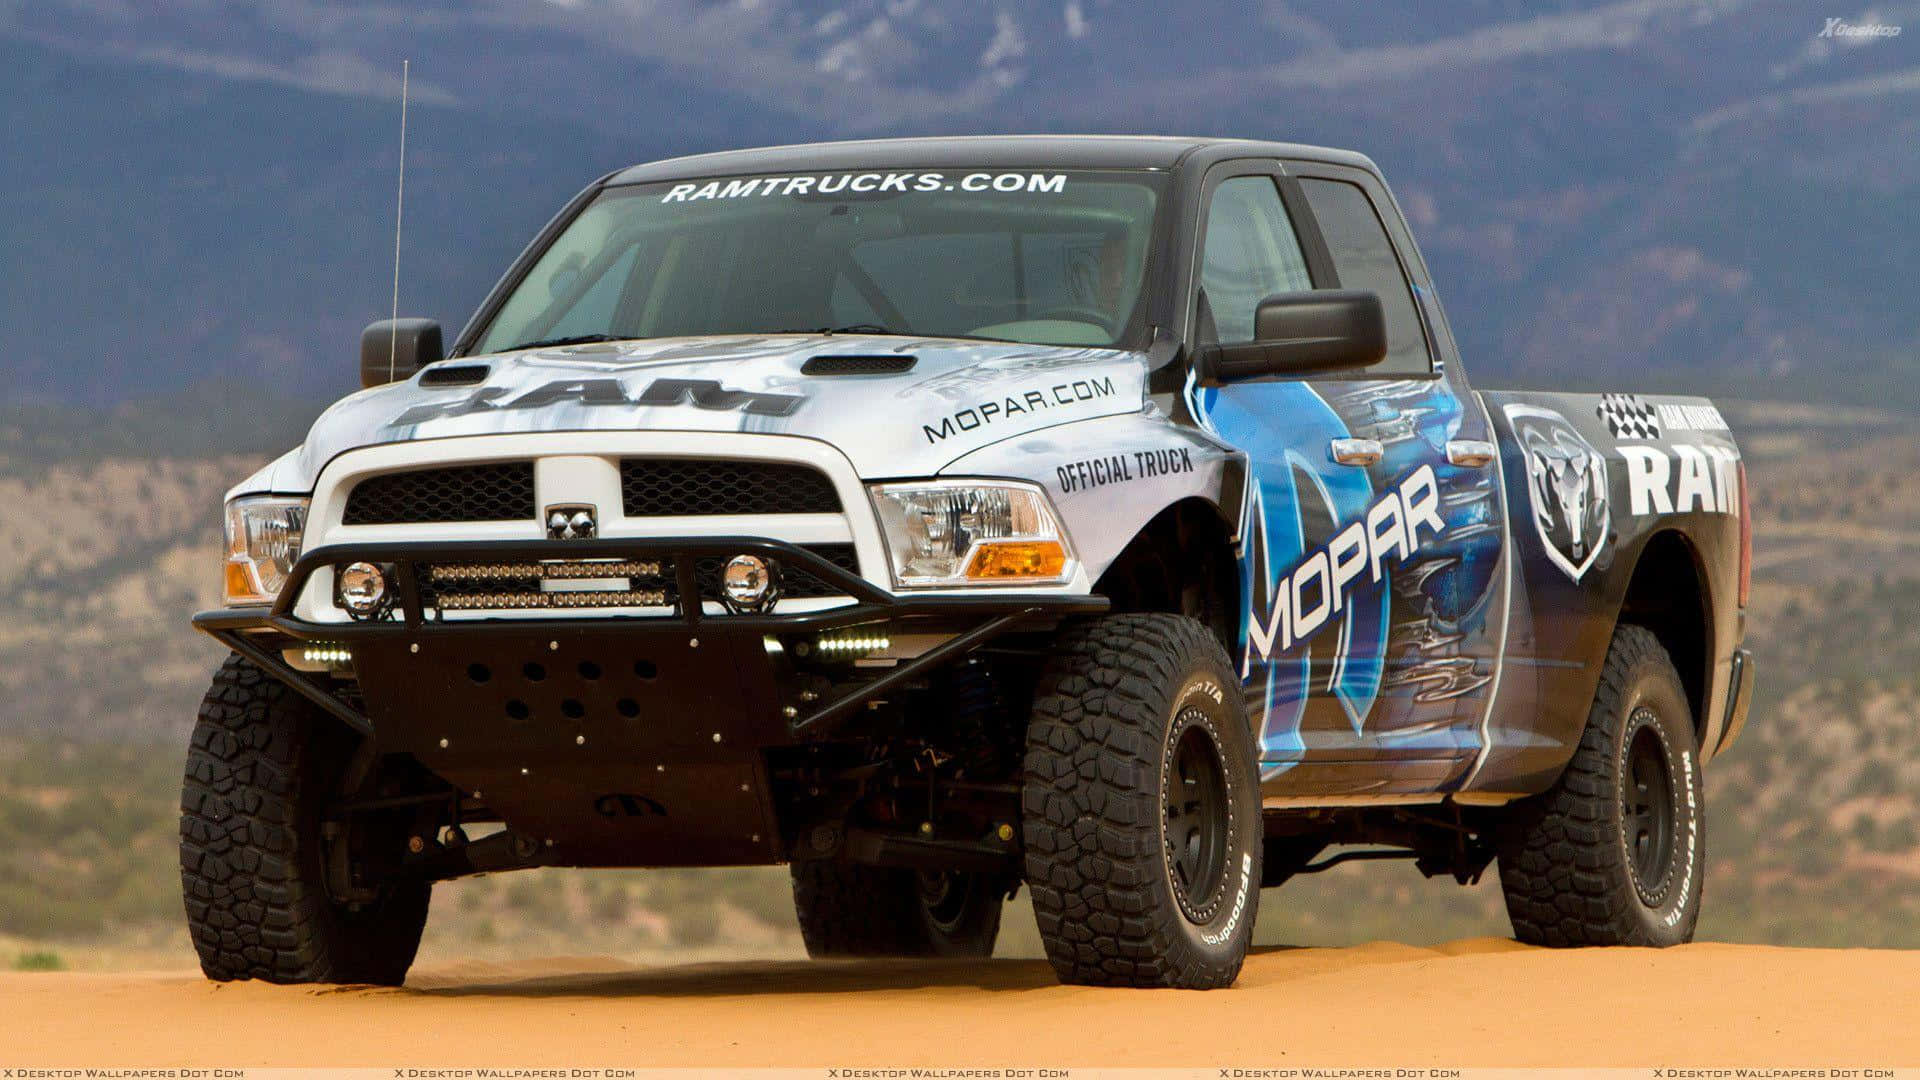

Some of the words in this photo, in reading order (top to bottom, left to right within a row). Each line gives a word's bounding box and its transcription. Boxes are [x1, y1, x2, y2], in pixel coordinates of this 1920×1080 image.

[661, 173, 1067, 203] RAMTRUCKS.COM
[922, 376, 1115, 443] MOPAR.COM
[1056, 457, 1133, 493] OFFICIAL
[1138, 448, 1193, 479] TRUCK
[1241, 464, 1446, 680] MOPAR
[1201, 852, 1251, 944] BFGoodrich
